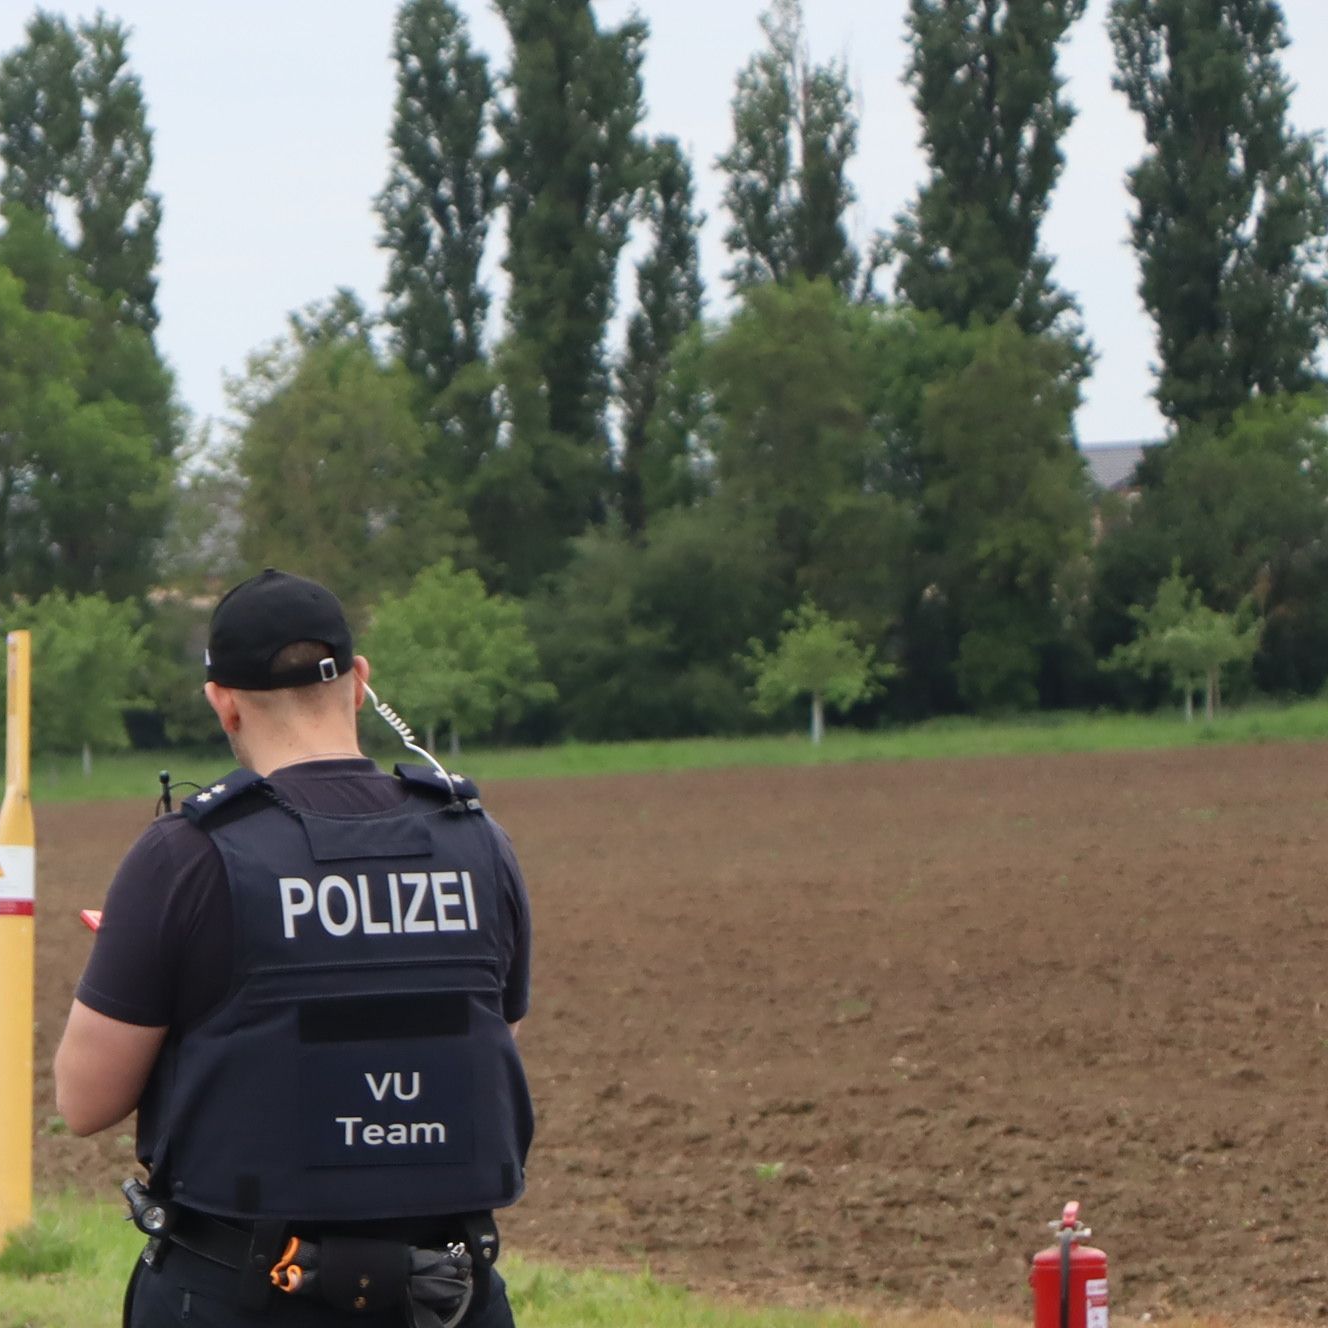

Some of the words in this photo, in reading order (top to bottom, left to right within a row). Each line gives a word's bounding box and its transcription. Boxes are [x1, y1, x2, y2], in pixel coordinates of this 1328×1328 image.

[279, 871, 478, 938] POLIZEI
[364, 1072, 420, 1101] VU
[335, 1117, 446, 1145] Team
